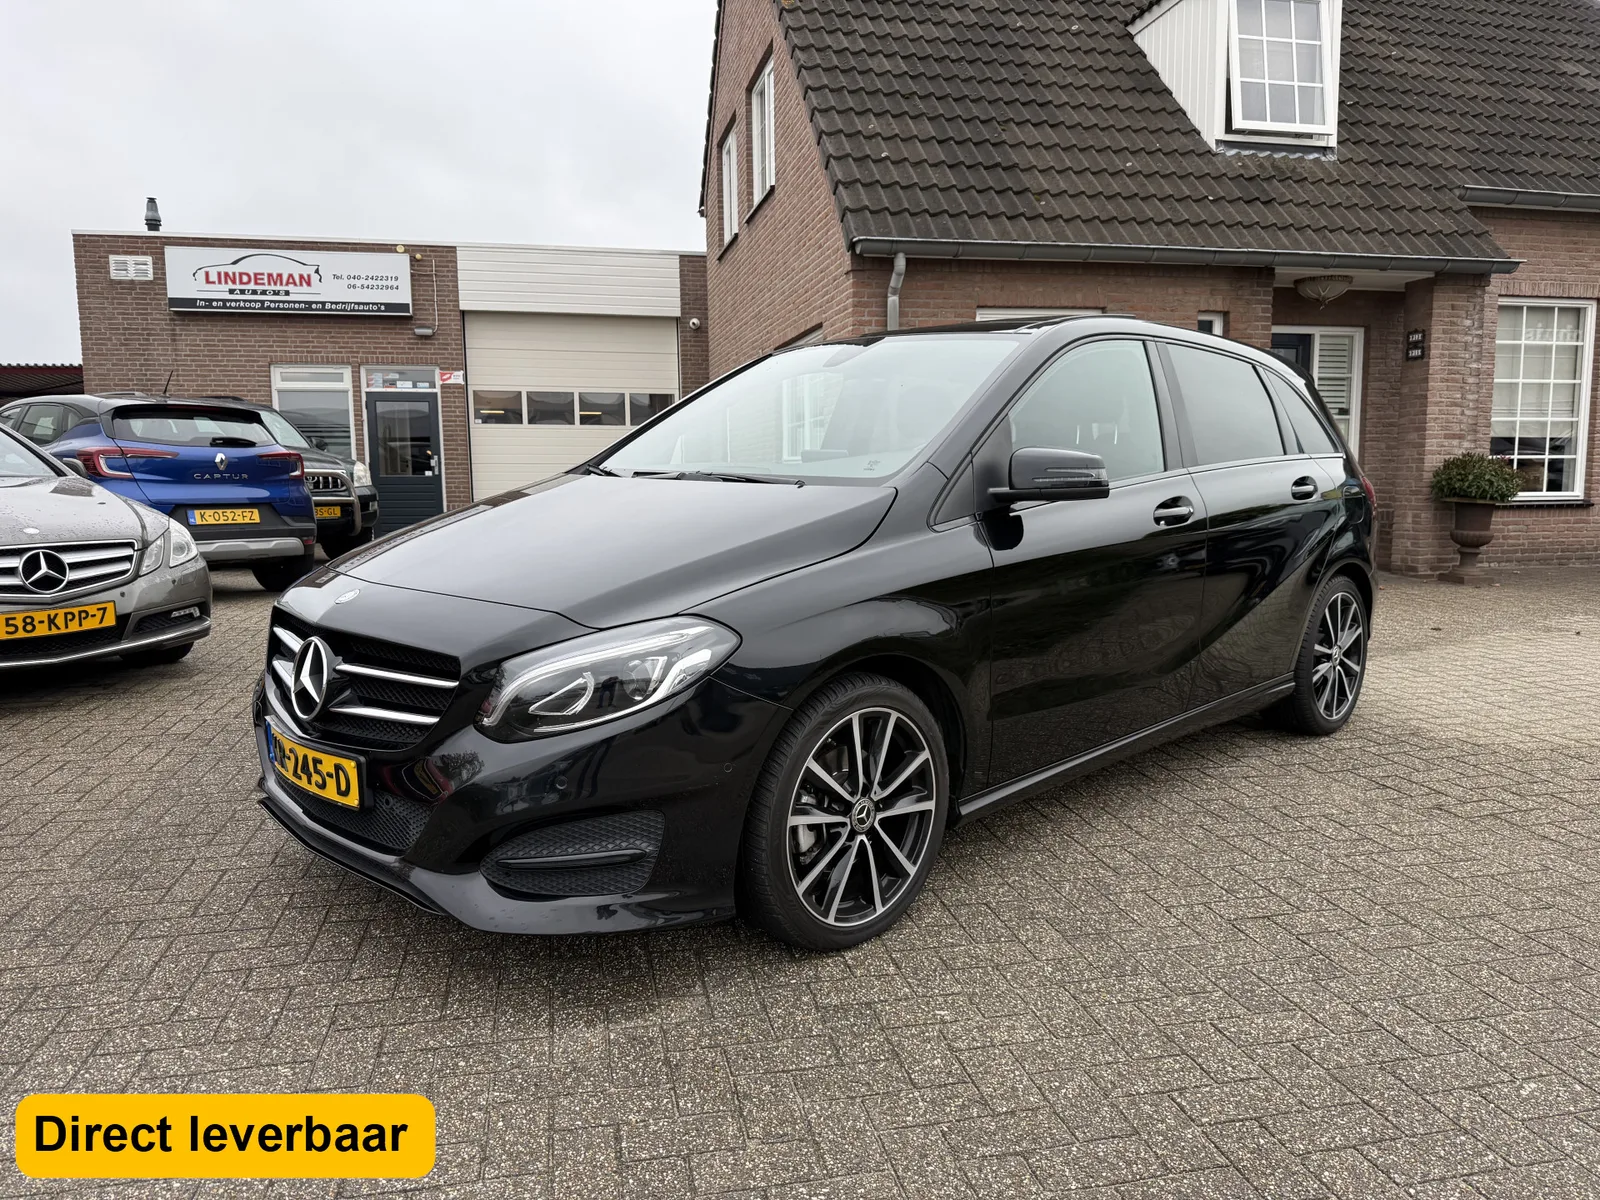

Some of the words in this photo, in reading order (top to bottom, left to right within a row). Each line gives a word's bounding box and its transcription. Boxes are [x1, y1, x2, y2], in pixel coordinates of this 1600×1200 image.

[204, 271, 312, 287] LINDEMAN
[346, 274, 399, 282] 040-2422319
[226, 301, 261, 309] verkoop
[264, 301, 309, 309] Personen-
[325, 302, 385, 311] Bedrijfsauto's
[199, 510, 256, 522] K-052-FZ
[4, 606, 108, 635] 58-KPP-7
